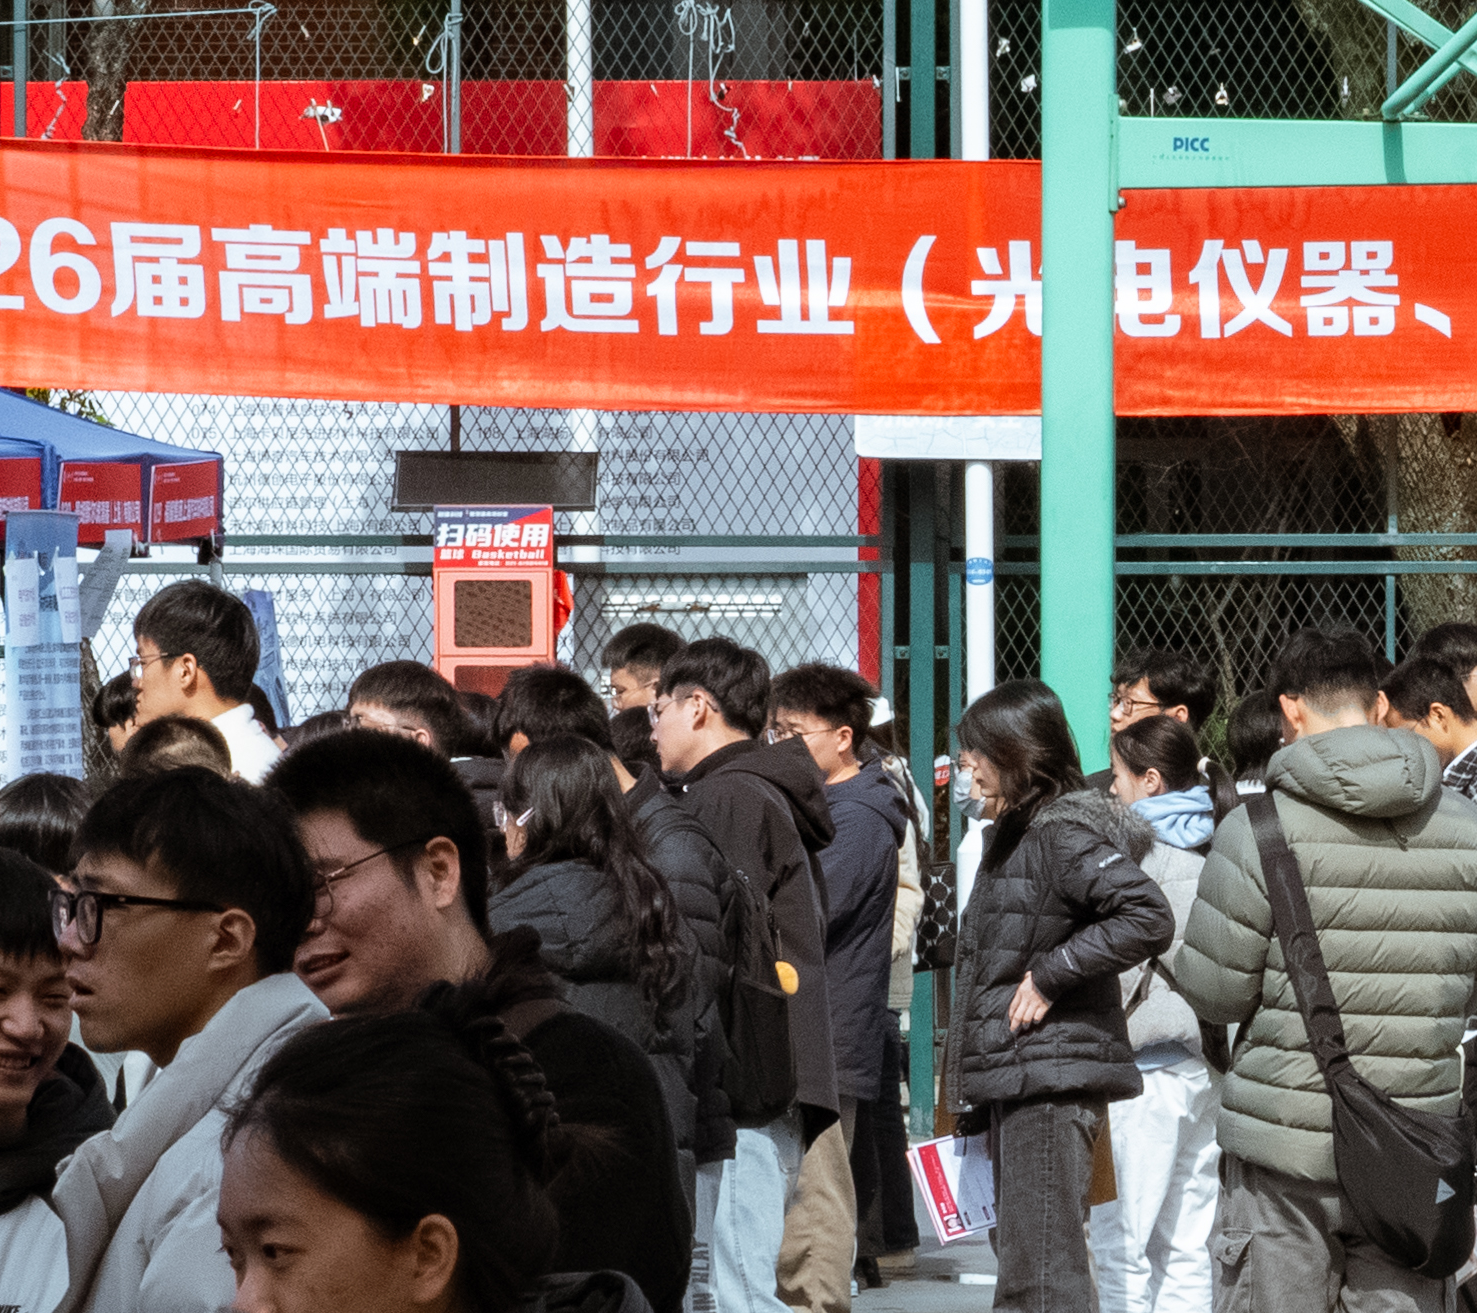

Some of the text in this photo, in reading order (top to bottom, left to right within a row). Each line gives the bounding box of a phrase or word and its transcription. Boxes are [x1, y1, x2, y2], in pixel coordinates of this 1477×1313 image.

[1173, 137, 1210, 152] PICC
[437, 523, 550, 548] 扫码使用
[471, 549, 545, 560] Basketball
